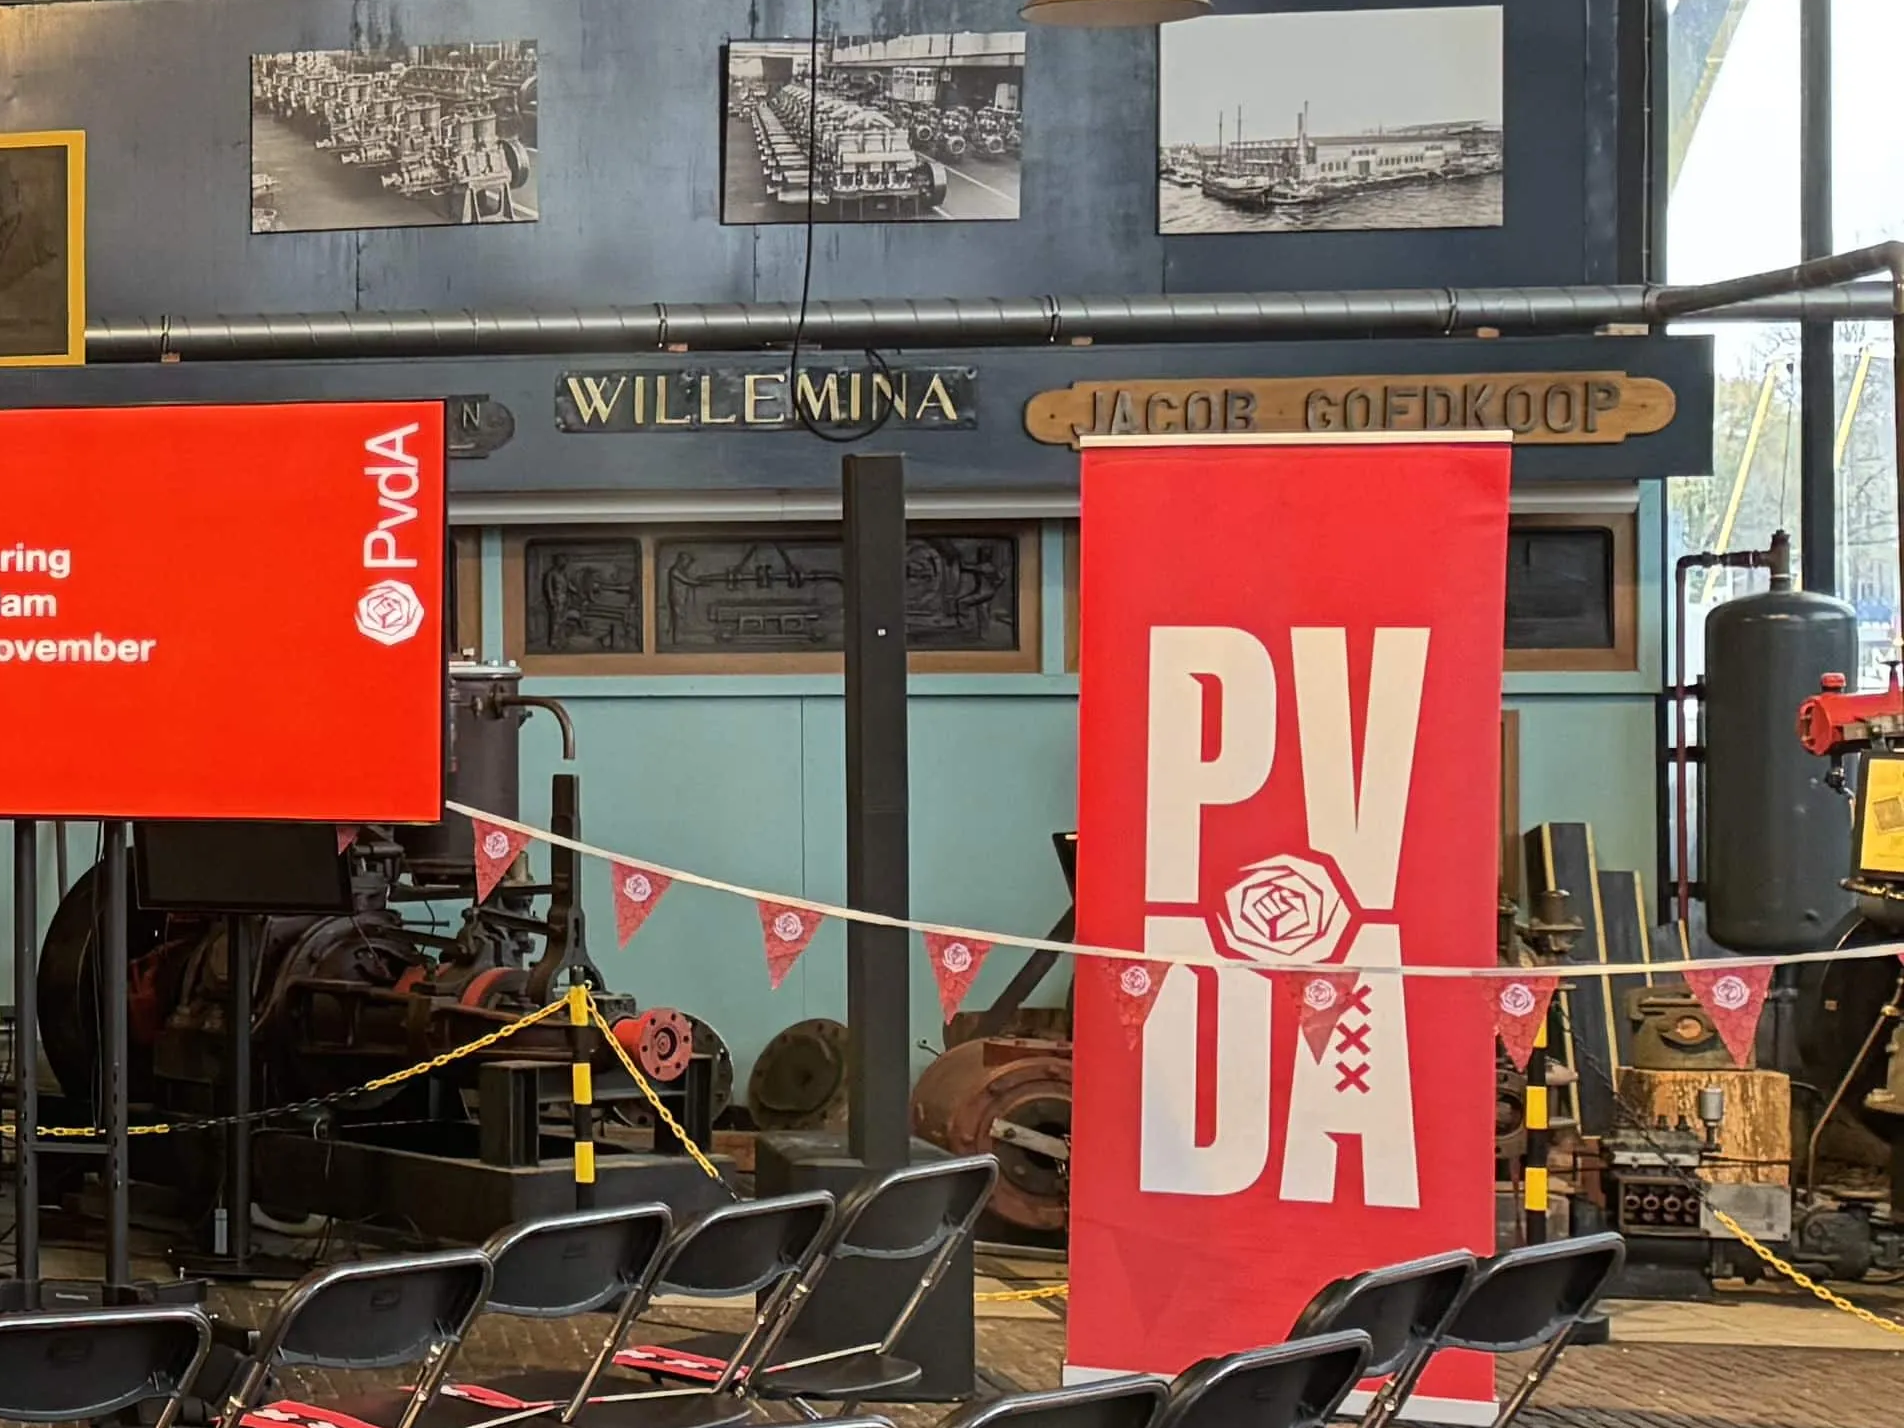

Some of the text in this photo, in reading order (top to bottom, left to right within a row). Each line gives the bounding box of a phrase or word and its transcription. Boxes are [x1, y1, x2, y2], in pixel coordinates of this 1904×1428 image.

[567, 373, 958, 424] WILLEMINA
[1071, 388, 1258, 435] JACOB
[363, 422, 420, 568] PvdA
[1145, 625, 1431, 910] PV
